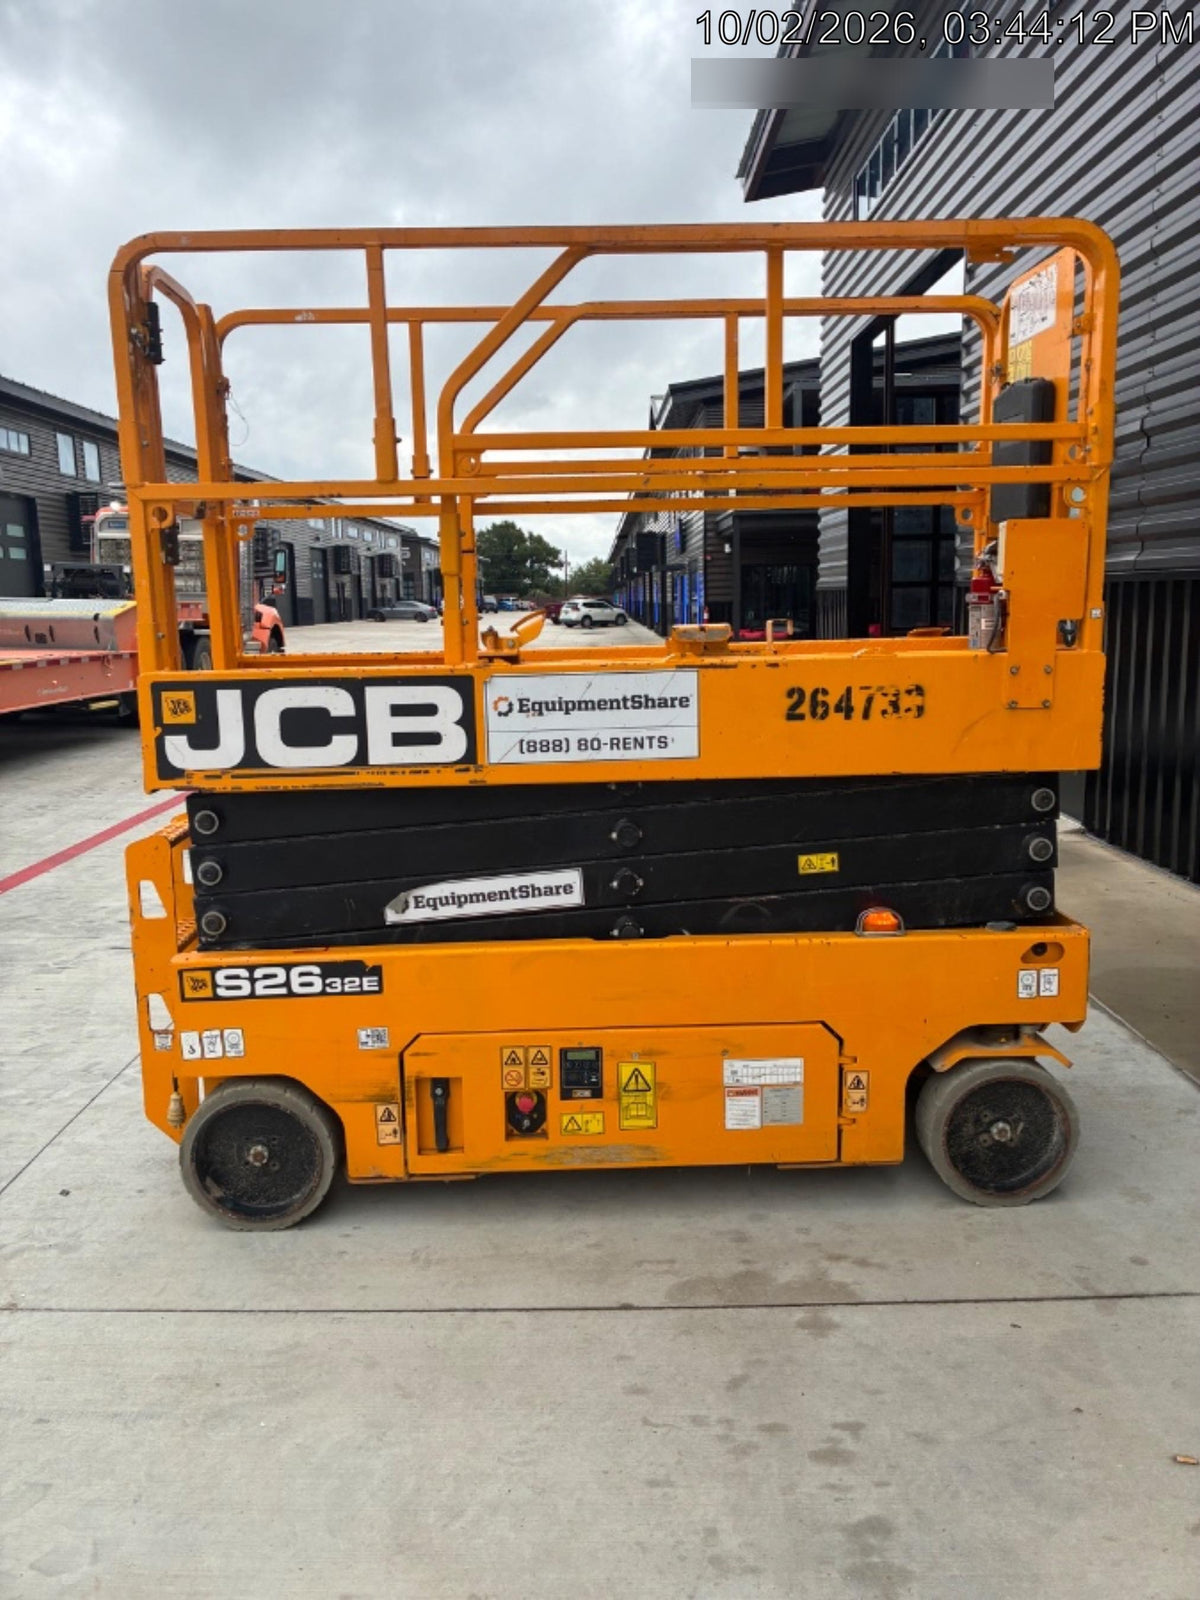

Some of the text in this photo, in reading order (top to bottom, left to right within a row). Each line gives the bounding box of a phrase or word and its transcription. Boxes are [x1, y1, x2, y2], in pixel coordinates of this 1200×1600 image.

[517, 693, 691, 717] EquipmentShare
[163, 685, 468, 770] JCB
[519, 735, 669, 755] (888) 80-RENTS
[412, 882, 574, 911] EquipmentShare
